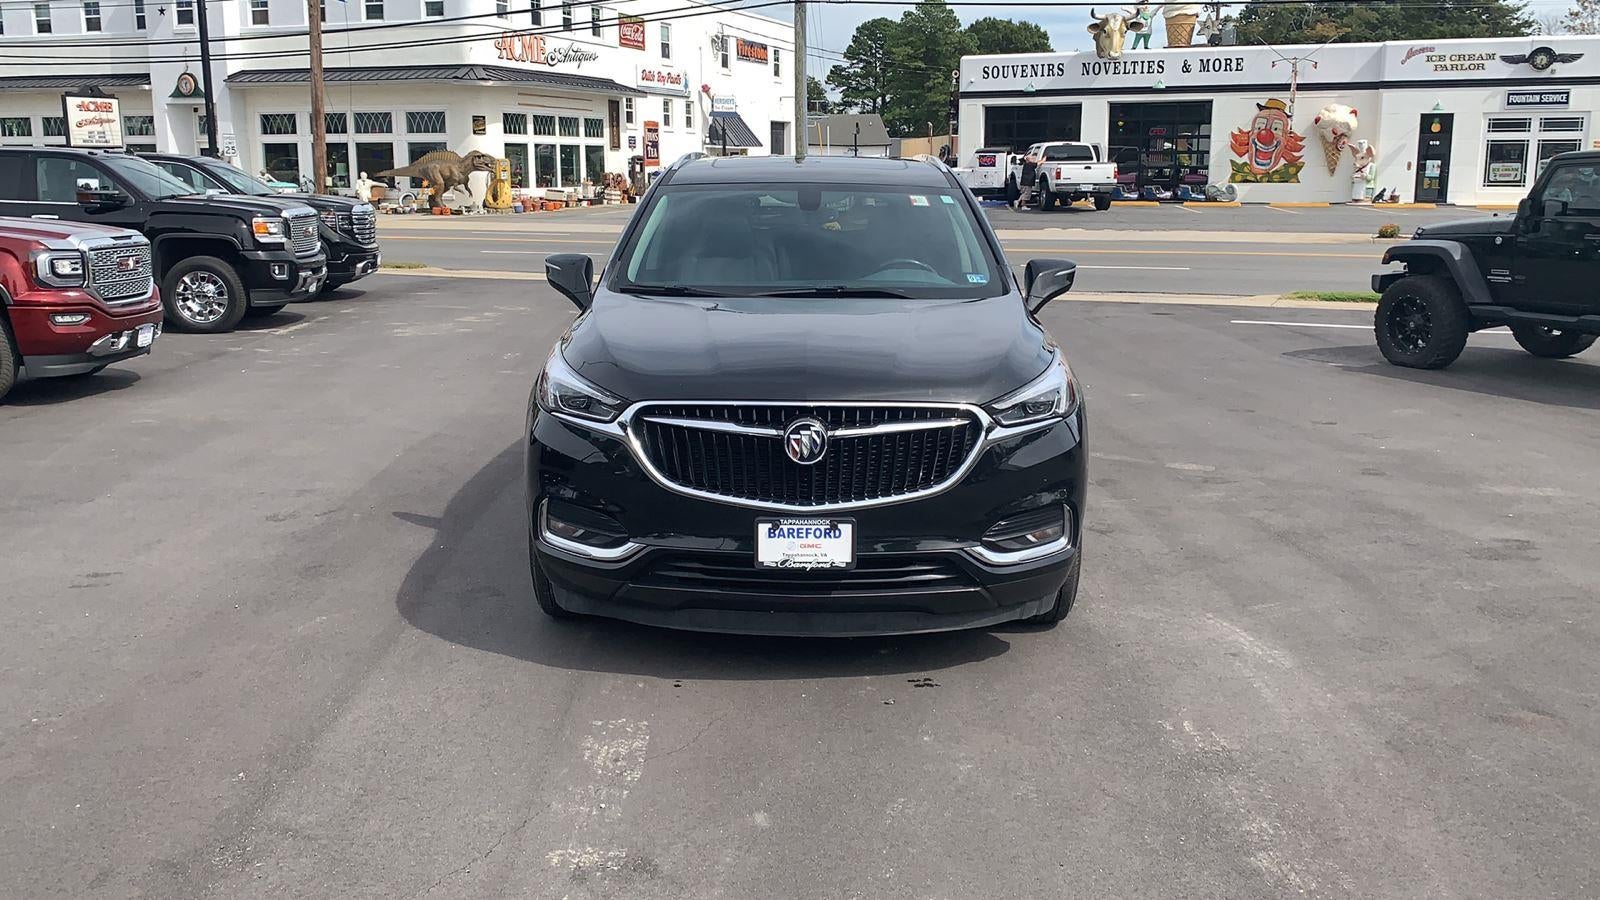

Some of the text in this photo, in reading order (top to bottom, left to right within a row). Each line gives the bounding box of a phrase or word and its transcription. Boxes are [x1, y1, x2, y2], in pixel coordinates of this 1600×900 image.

[494, 32, 599, 69] ACME Antiques
[737, 38, 768, 60] Firestone
[1425, 55, 1446, 63] ICE
[1449, 53, 1496, 62] CREAM
[982, 57, 1244, 80] SOUVENIRS NOVELTIES & MORE
[1433, 63, 1485, 72] PARLOR
[641, 69, 682, 85] Dutch Boy Paints
[1509, 93, 1568, 104] FOUNTAIN SERVICE
[76, 101, 113, 112] ACME
[225, 145, 236, 155] 25
[648, 147, 658, 158] TEA
[767, 527, 842, 539] BAREFORD
[778, 559, 832, 571] Bareford
